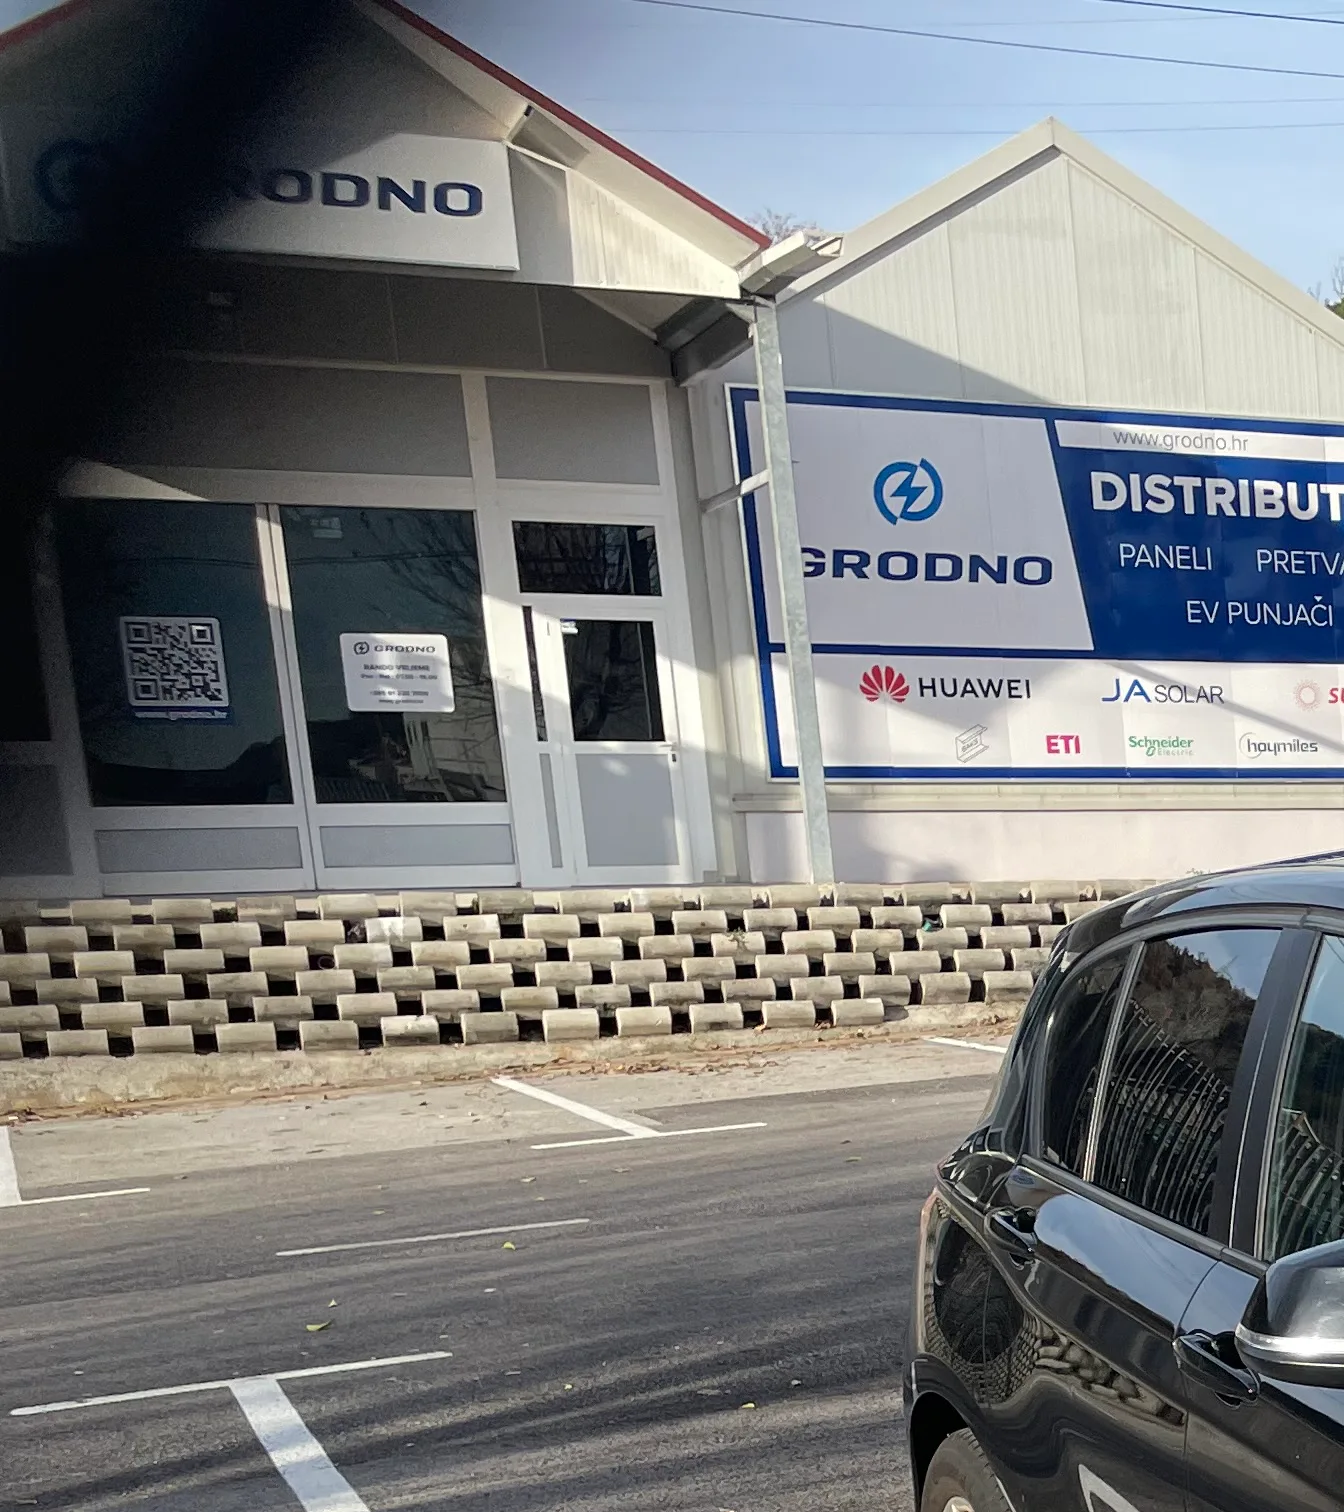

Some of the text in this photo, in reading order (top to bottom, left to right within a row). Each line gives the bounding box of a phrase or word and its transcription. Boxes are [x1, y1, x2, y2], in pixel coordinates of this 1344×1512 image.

[1113, 430, 1249, 452] www.grodno.hr
[1119, 543, 1212, 571] PANELI
[1187, 600, 1219, 624] EV
[1228, 596, 1334, 627] PUNJAČI
[374, 645, 436, 654] GRODNO
[918, 677, 1032, 699] HUAWEI
[1101, 678, 1225, 705] JA SOLAR
[1045, 735, 1081, 754] ETI
[1128, 735, 1195, 750] Schneider
[1247, 738, 1319, 756] hoymiles
